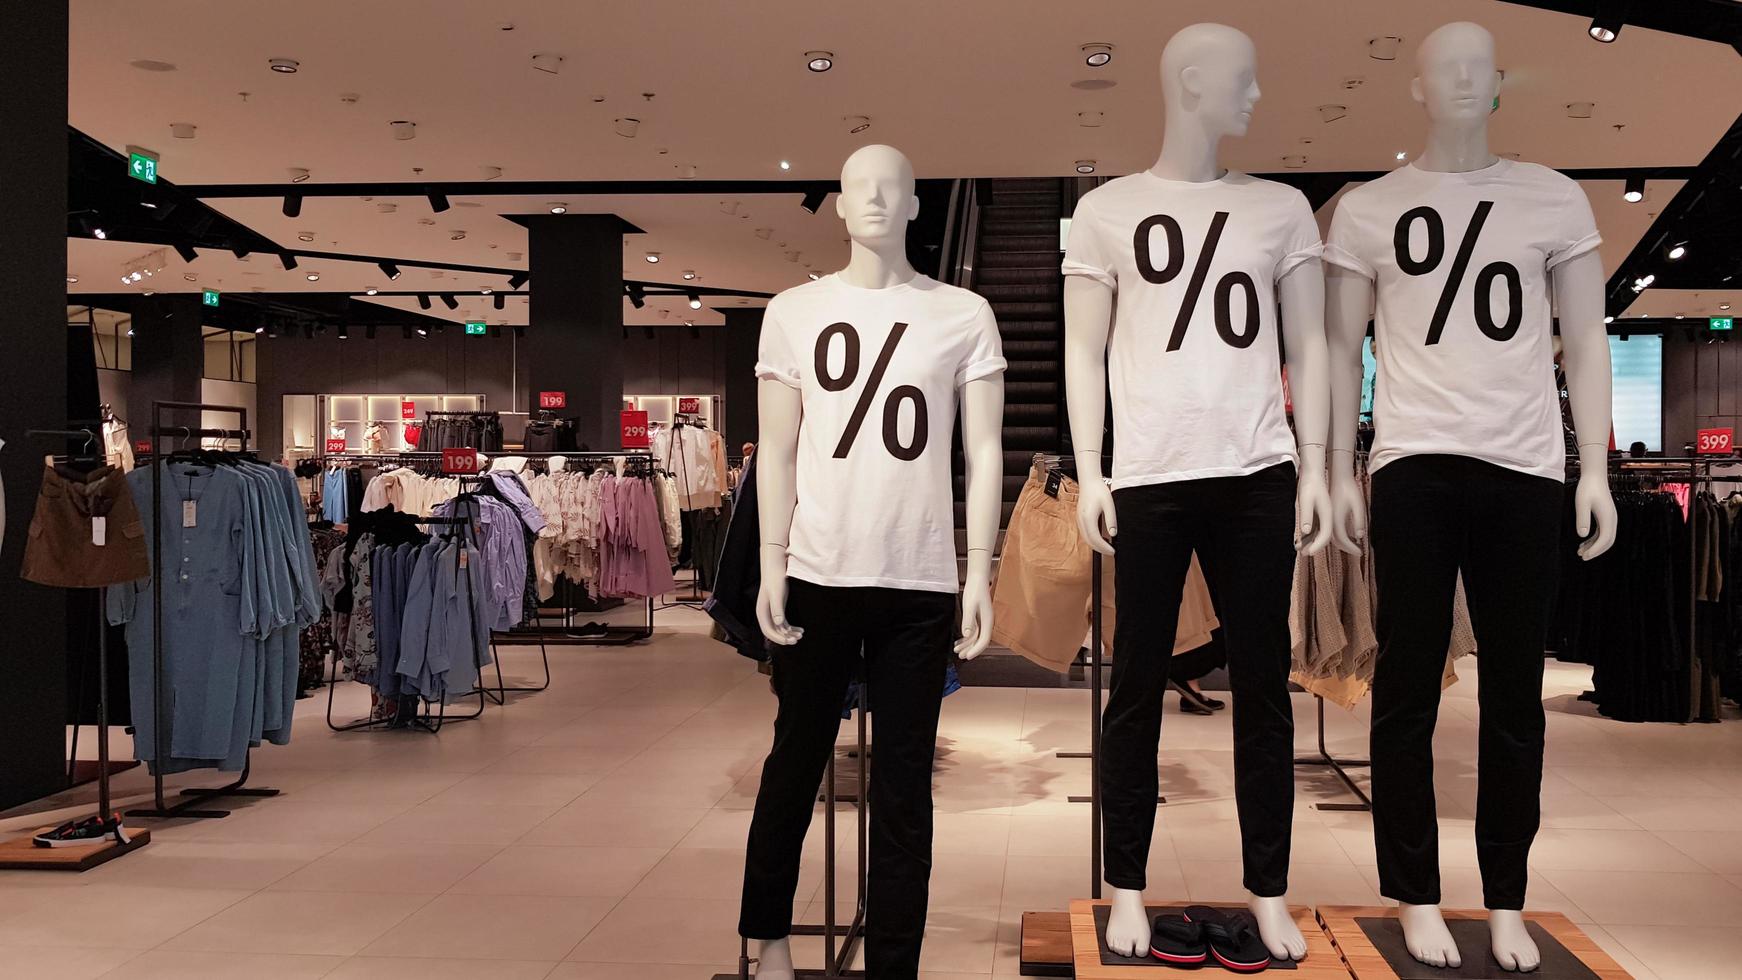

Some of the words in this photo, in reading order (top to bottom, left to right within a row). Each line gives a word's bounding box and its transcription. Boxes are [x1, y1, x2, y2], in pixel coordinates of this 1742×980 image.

[1393, 200, 1523, 346] %
[1133, 211, 1261, 353] %
[814, 322, 929, 462] %
[543, 396, 563, 406] 199
[680, 402, 697, 411] 399
[624, 426, 646, 437] 299
[328, 442, 344, 450] 299
[1700, 434, 1729, 450] 399
[447, 455, 474, 470] 199
